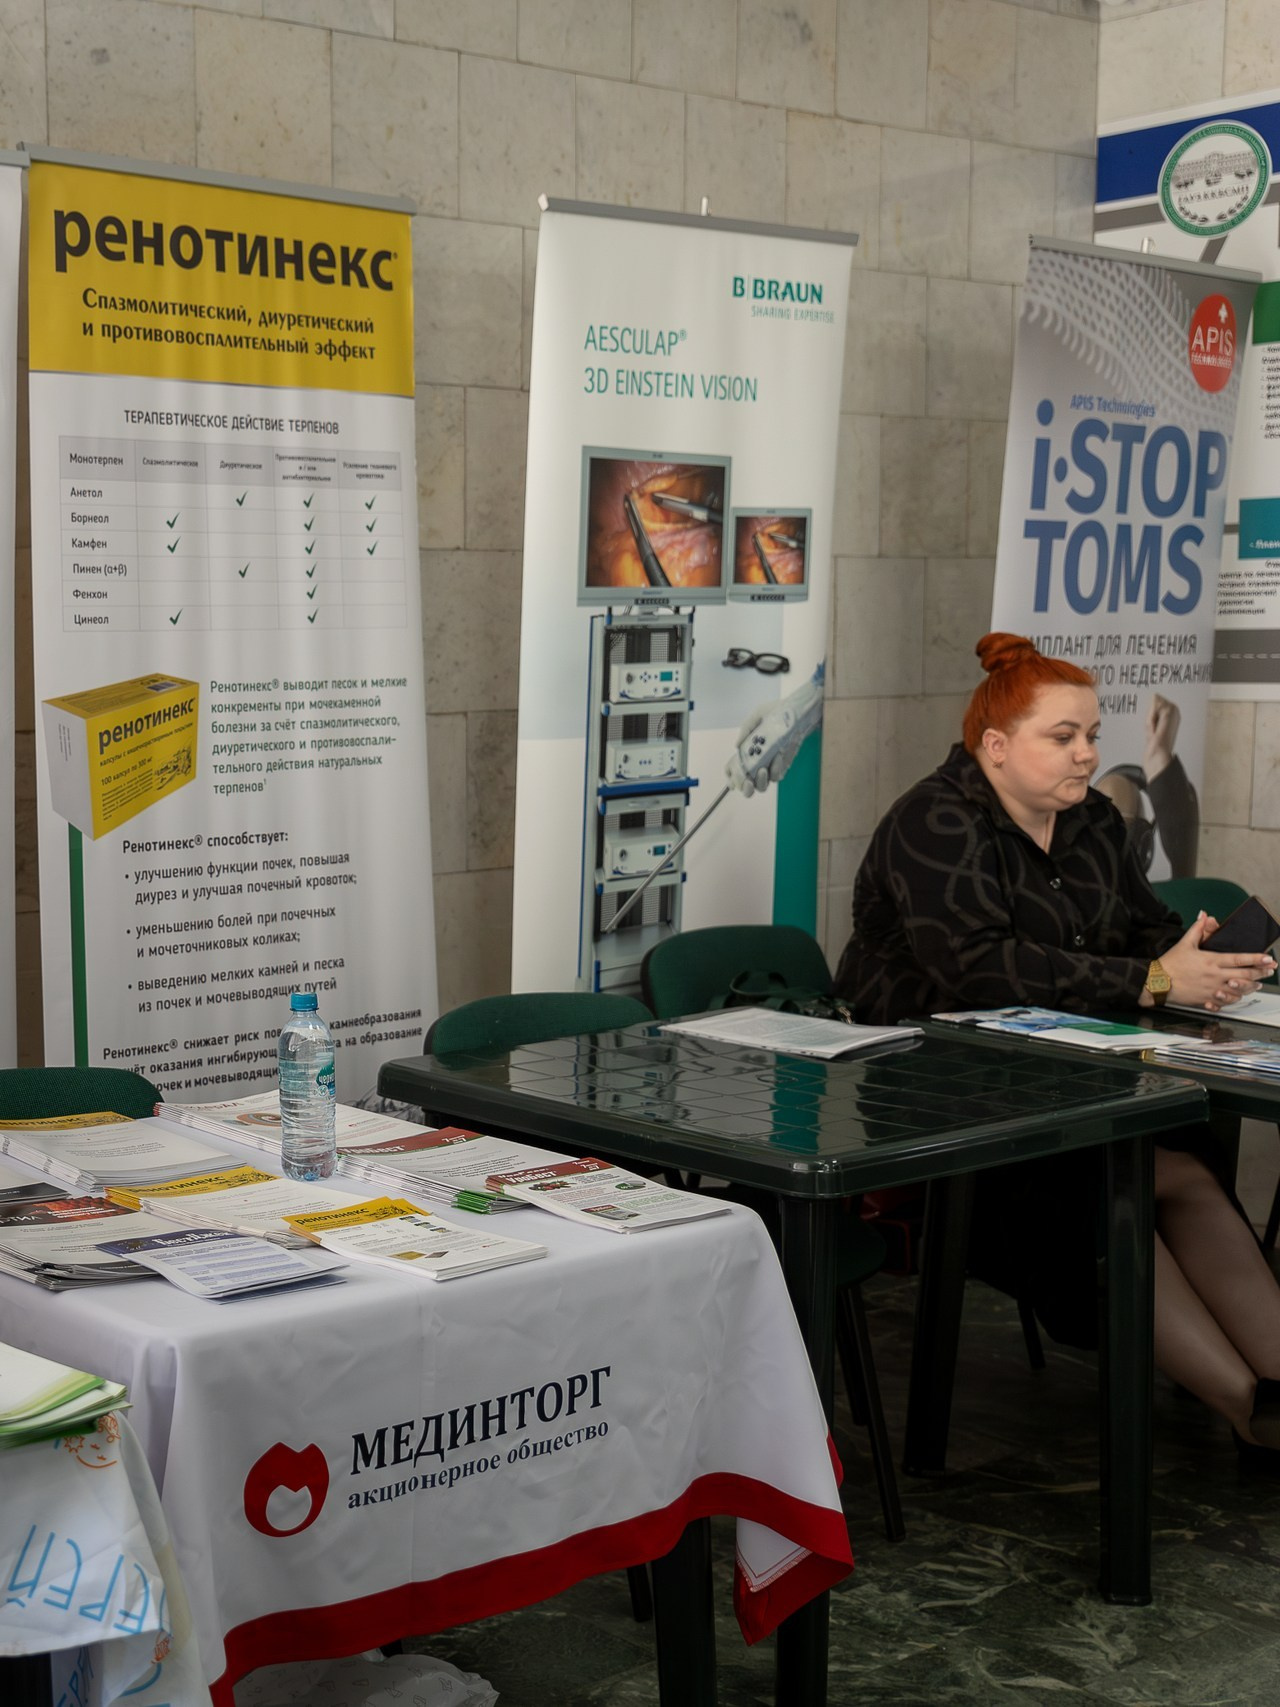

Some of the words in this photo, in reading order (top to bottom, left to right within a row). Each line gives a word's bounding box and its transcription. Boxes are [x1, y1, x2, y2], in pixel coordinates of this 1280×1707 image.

[732, 276, 745, 298] B
[752, 280, 822, 305] BRAUN
[82, 287, 252, 326] Спазмолитический,
[258, 309, 375, 334] диуретический
[751, 306, 791, 320] SHARING
[794, 309, 835, 324] EXPERTISE
[82, 322, 94, 337] и
[101, 323, 309, 355] противовоспалительный
[315, 340, 376, 362] эффект
[584, 324, 687, 356] AESCULAP®
[1192, 324, 1234, 356] APIS
[584, 367, 609, 394] 3D
[615, 369, 694, 399] EINSTEIN
[701, 375, 757, 401] VISION
[1070, 394, 1094, 411] APIS
[1097, 397, 1156, 418] Technologies
[124, 409, 228, 430] ТЕРАПЕВТИЧЕСКОЕ
[231, 416, 285, 433] ДЕЙСТВИЕ
[288, 418, 339, 434] ТЕРПЕНОВ
[69, 453, 124, 467] Монотерпен
[70, 487, 103, 499] Анетол
[70, 513, 109, 525] Борнеол
[71, 538, 107, 551] Камфен
[1024, 519, 1204, 616] TOMS
[73, 589, 108, 601] Фенхон
[74, 614, 109, 627] Цинеол
[1094, 635, 1121, 658] ДЛЯ
[1126, 634, 1197, 656] ЛЕЧЕНИЯ
[210, 679, 280, 694] Ренотинекс®
[283, 679, 329, 692] выводит
[331, 680, 358, 691] песок
[361, 680, 367, 688] и
[371, 676, 407, 688] мелкие
[122, 835, 203, 854] Ренотинекс®
[207, 830, 289, 850] способствует:
[134, 865, 203, 884] улучшению
[206, 860, 258, 878] функции
[262, 857, 296, 871] почек,
[299, 853, 350, 867] повышая
[294, 1207, 369, 1226] ренотинекс
[350, 1365, 611, 1476] МЕДИНТОРГ
[348, 1454, 501, 1510] акционерное
[506, 1421, 609, 1464] общество
